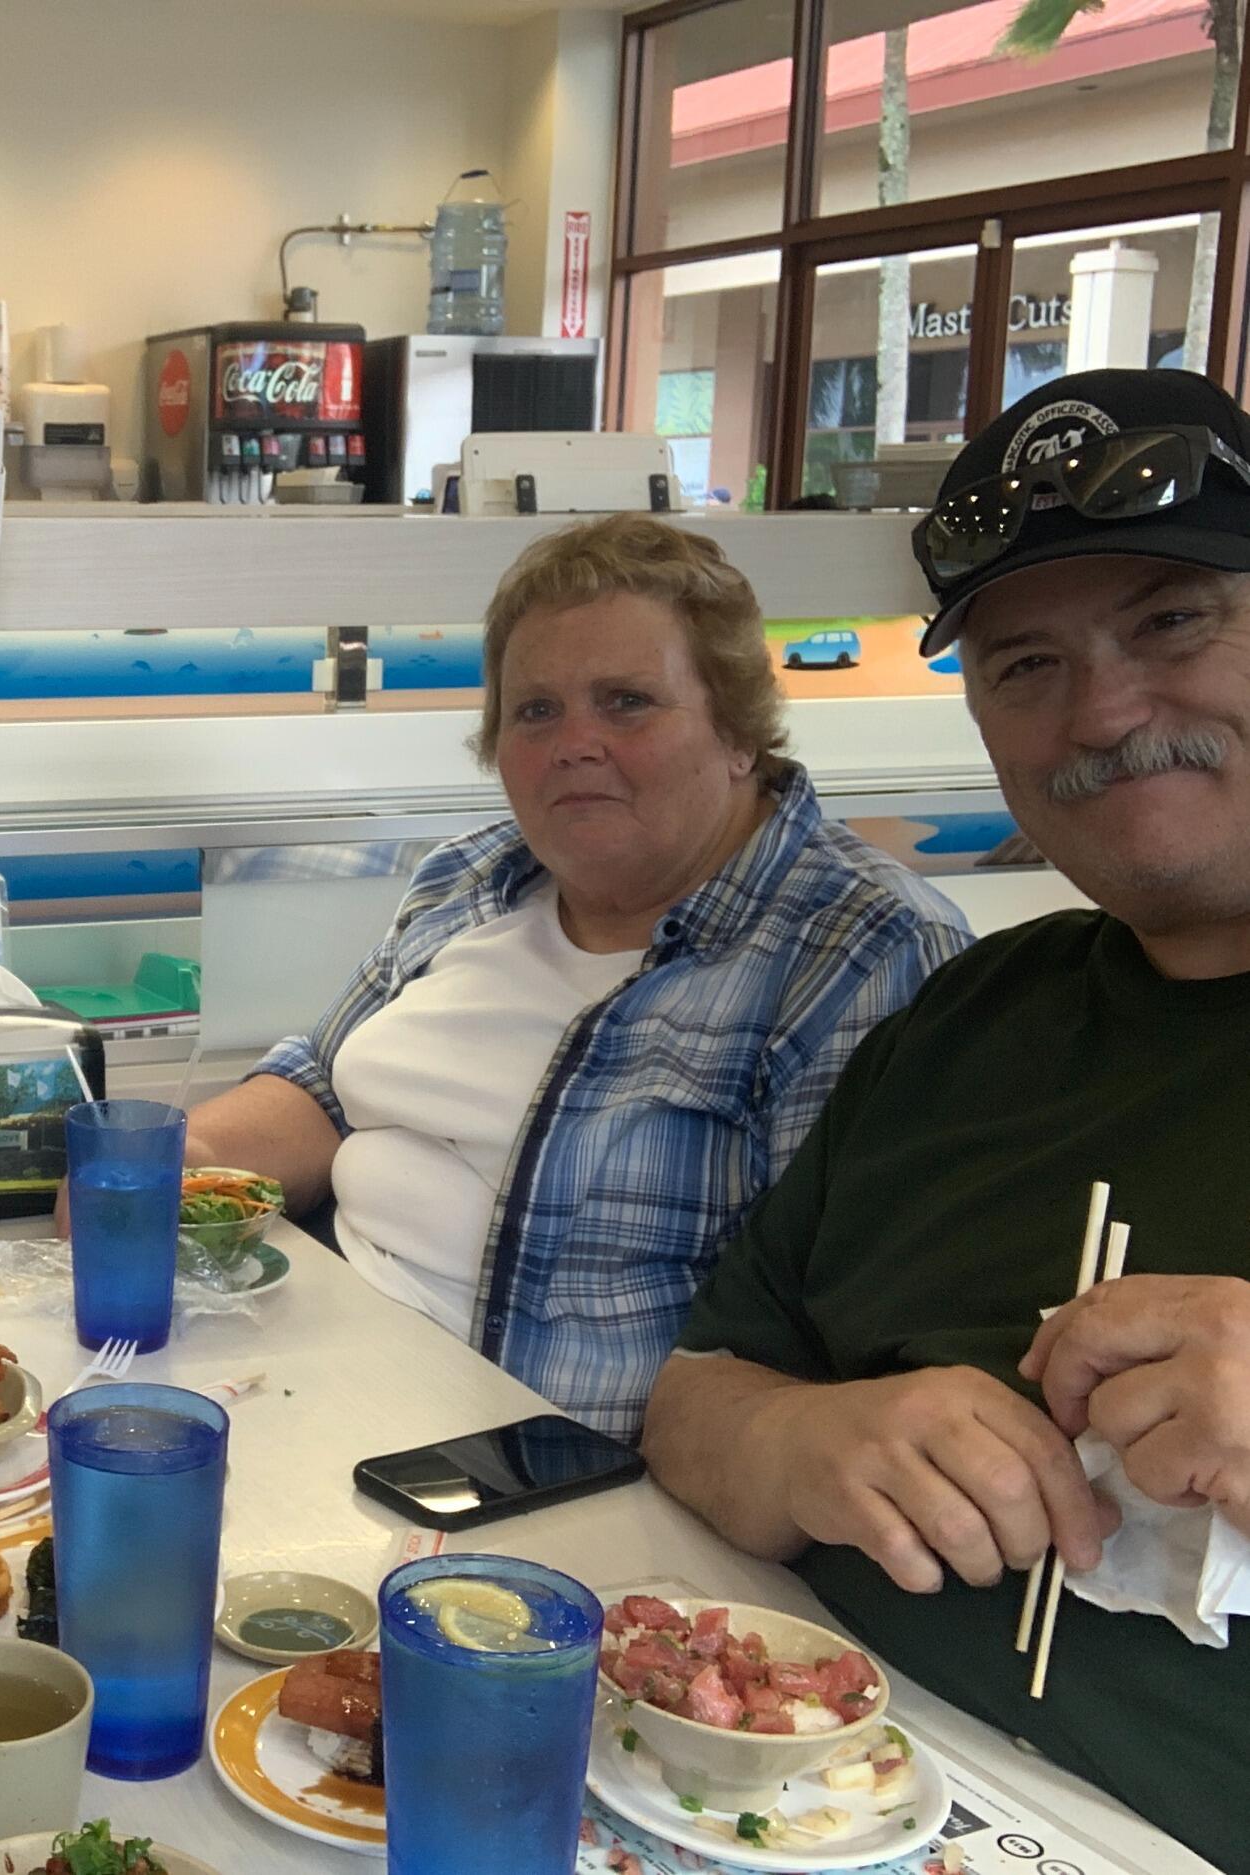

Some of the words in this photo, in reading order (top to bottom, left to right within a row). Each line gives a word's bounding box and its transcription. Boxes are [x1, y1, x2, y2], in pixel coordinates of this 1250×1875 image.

[908, 302, 971, 338] Mast
[223, 361, 322, 403] Coca-Cola
[1036, 404, 1092, 422] OFFICERS
